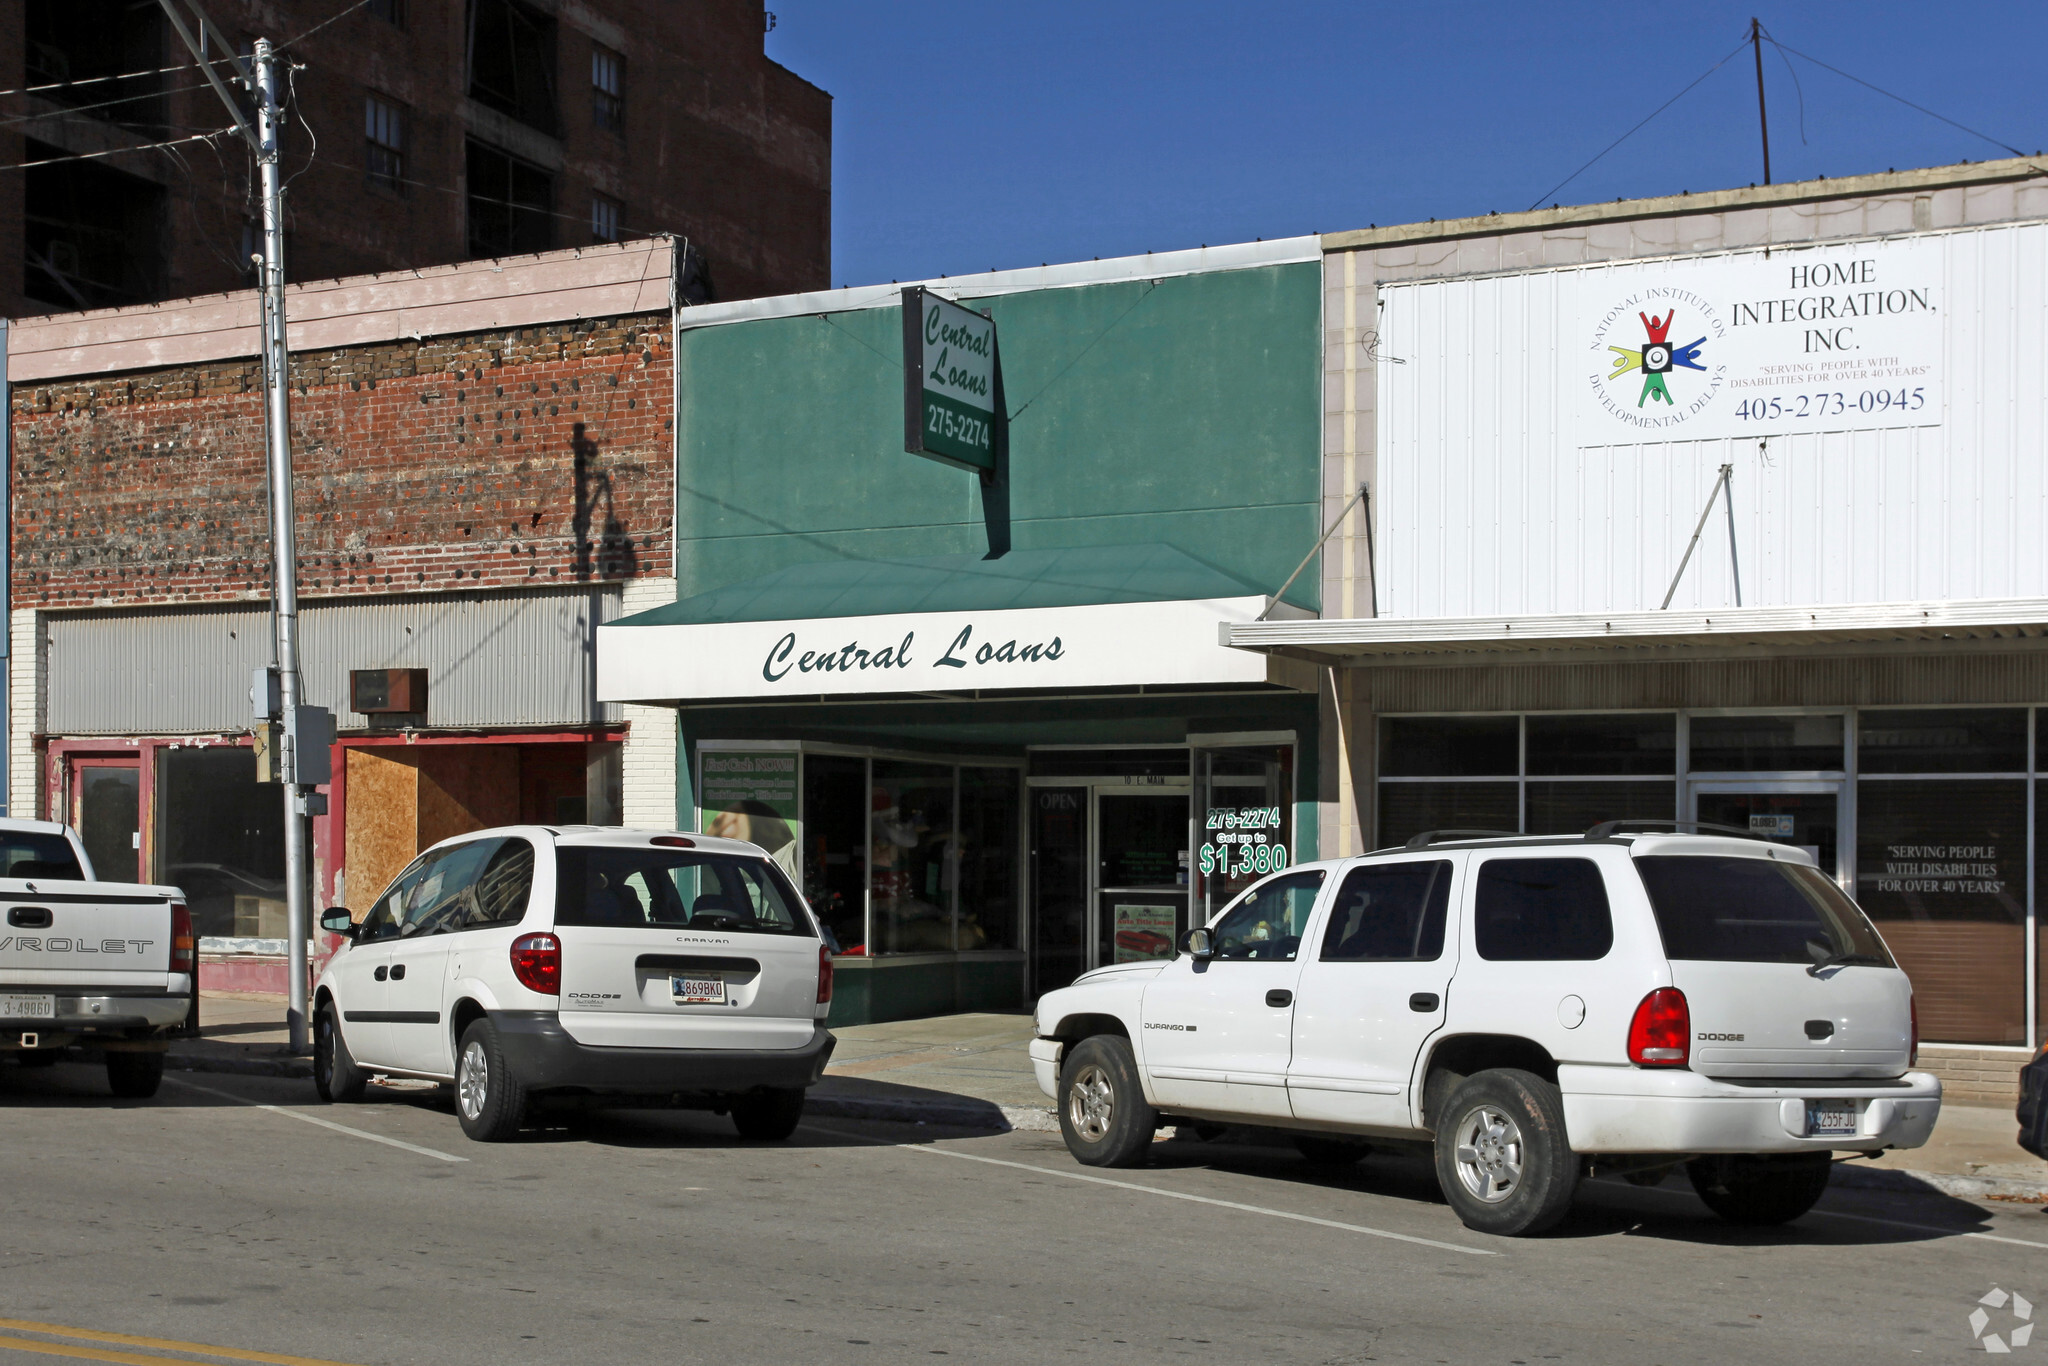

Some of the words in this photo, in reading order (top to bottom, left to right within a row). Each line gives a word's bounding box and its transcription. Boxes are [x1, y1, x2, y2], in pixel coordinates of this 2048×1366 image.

[1789, 259, 1877, 290] HOME
[1731, 287, 1937, 327] INTEGRATION,
[1590, 293, 1643, 352] NATIONAL
[1646, 286, 1714, 322] INSTITUTE
[1711, 319, 1727, 340] ON
[925, 304, 990, 358] Central
[1803, 326, 1861, 354] INC.
[930, 346, 988, 397] Loans
[1730, 375, 1805, 389] DISABILITIES
[1806, 373, 1831, 384] FOR
[1835, 370, 1868, 382] OVER
[1870, 368, 1884, 379] 40
[1885, 365, 1931, 378] YEARS"
[1759, 361, 1814, 376] "SERVING
[1820, 358, 1864, 371] PEOPLE
[1867, 356, 1899, 368] WITH
[1589, 373, 1689, 429] DEVELOPMENTAL
[1689, 364, 1728, 415] DELAYS
[1735, 387, 1926, 421] 405-273-0945
[929, 404, 990, 450] 275-2274
[762, 630, 914, 682] Central
[932, 624, 1066, 669] Loans
[705, 758, 727, 772] Fast
[728, 757, 754, 772] Cash
[755, 758, 795, 772] NOW!!!
[1040, 792, 1078, 810] OPEN
[1206, 806, 1281, 829] 275-2274
[1751, 817, 1777, 828] CLOSED
[1216, 832, 1237, 843] Get
[1237, 834, 1253, 845] up
[1254, 832, 1267, 843] to
[1199, 842, 1287, 880] $1,380
[1887, 845, 1946, 859] "SERVING
[1949, 846, 1996, 860] PEOPLE
[1886, 863, 1920, 876] WITH
[1878, 879, 1903, 892] FOR
[1905, 879, 1939, 893] OVER
[1942, 880, 1956, 893] 40
[1958, 880, 2006, 894] YEARS"
[676, 936, 730, 944] CARAVAN
[1144, 1022, 1184, 1031] DURANGO
[1697, 1032, 1745, 1042] DODGE
